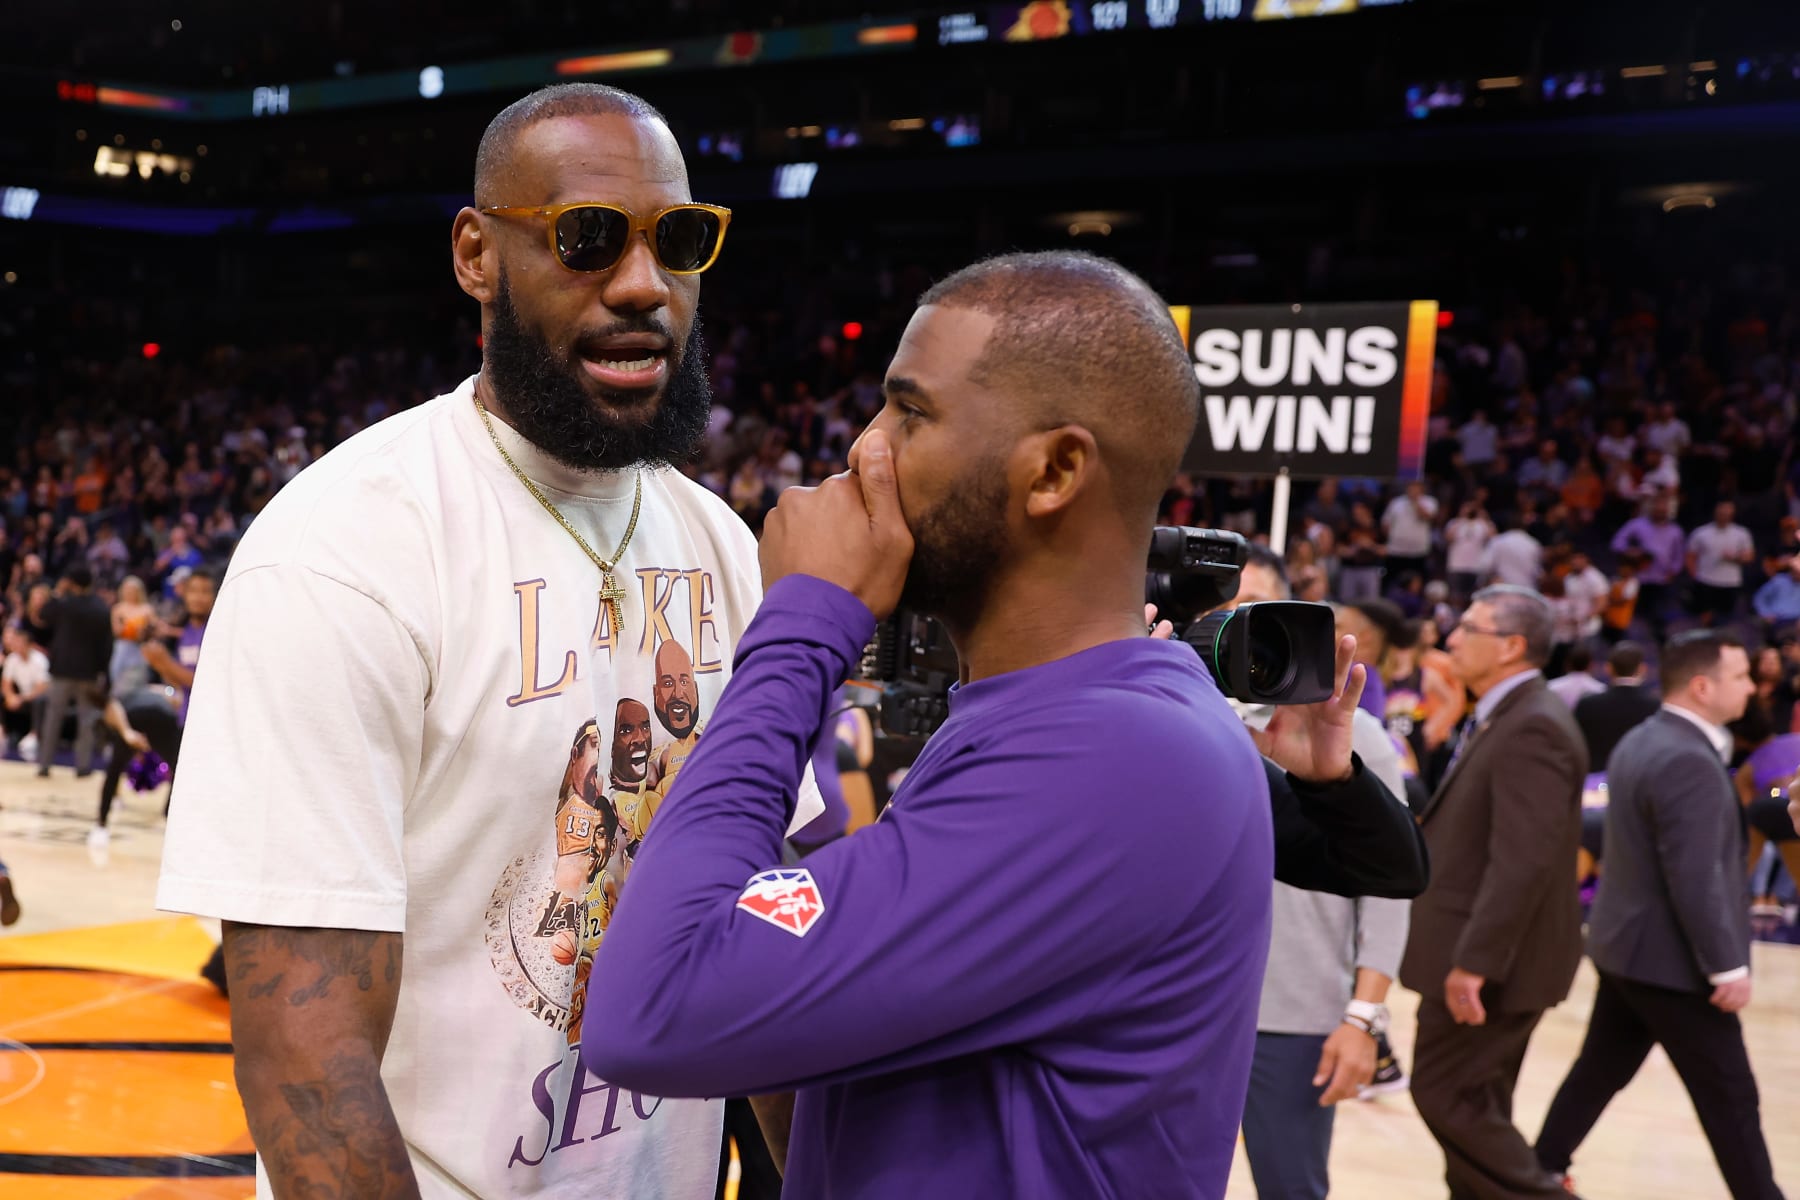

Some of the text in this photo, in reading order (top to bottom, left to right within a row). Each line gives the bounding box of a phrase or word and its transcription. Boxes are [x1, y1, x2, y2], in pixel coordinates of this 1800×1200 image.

[1195, 326, 1398, 387] SUNS
[1204, 395, 1376, 454] WIN!
[565, 815, 590, 838] 13
